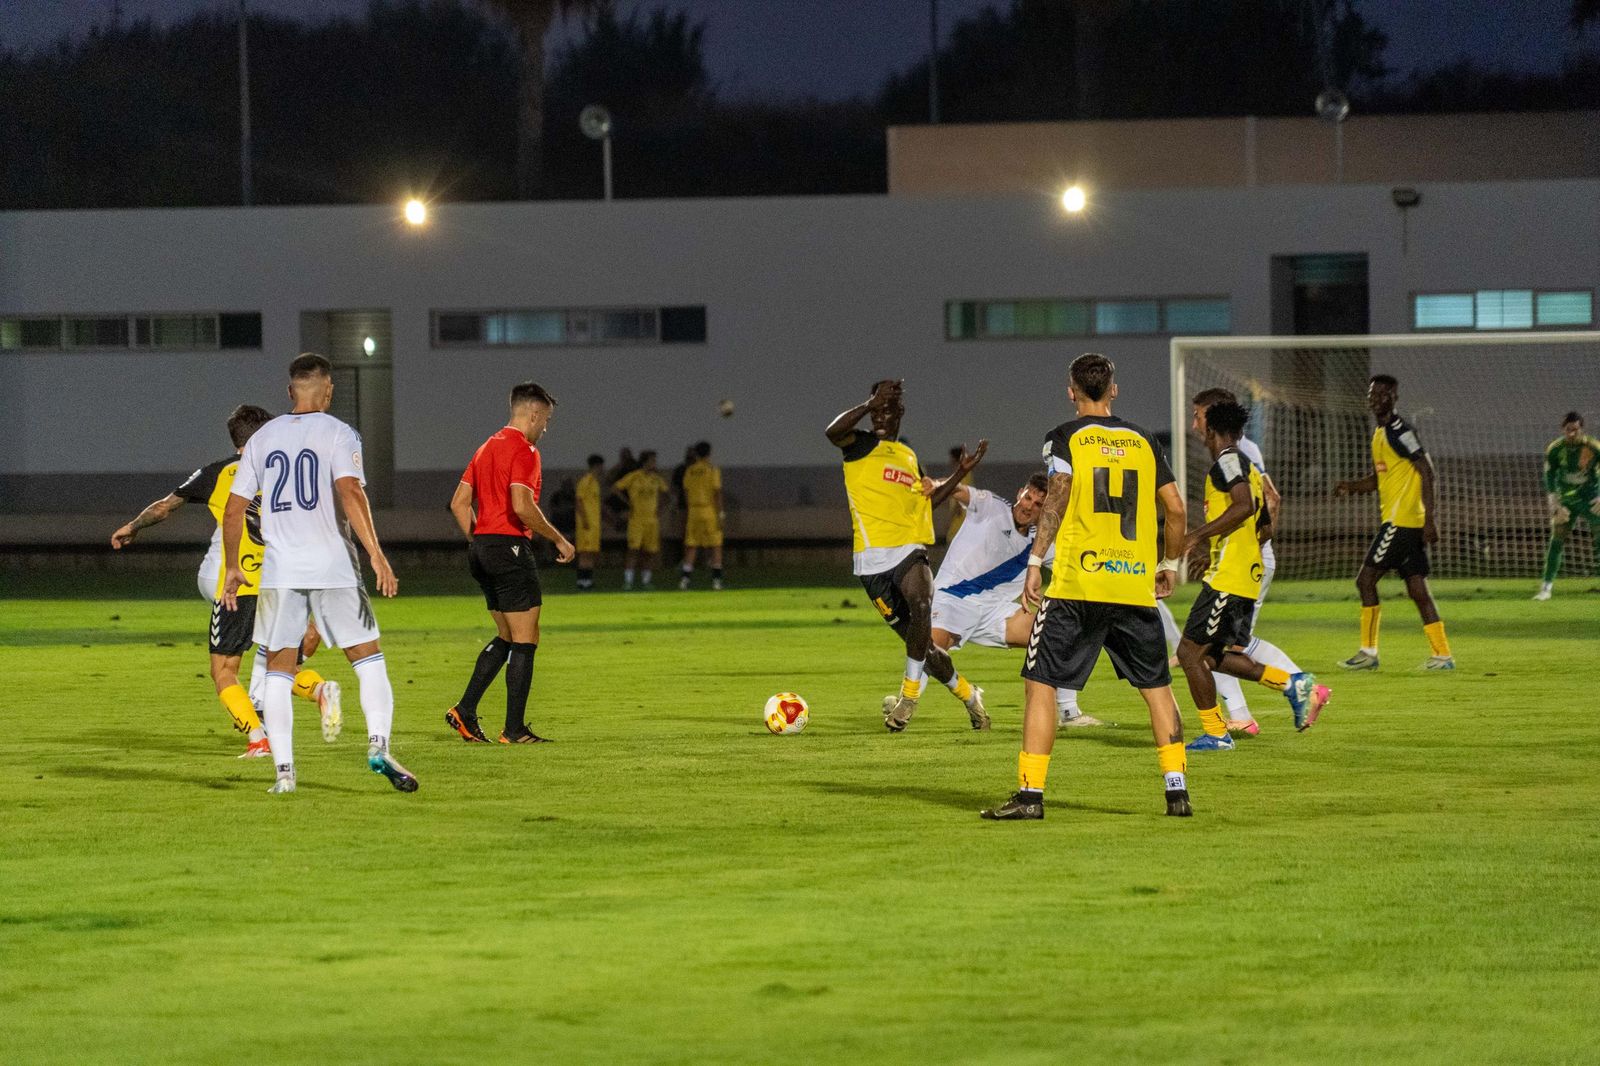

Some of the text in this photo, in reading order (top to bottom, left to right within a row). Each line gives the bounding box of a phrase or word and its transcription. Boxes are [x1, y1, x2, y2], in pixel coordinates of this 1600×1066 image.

[1079, 436, 1142, 449] LAS PALMERITAS
[265, 448, 319, 513] 20
[885, 470, 915, 484] el jam
[1093, 467, 1139, 541] 4
